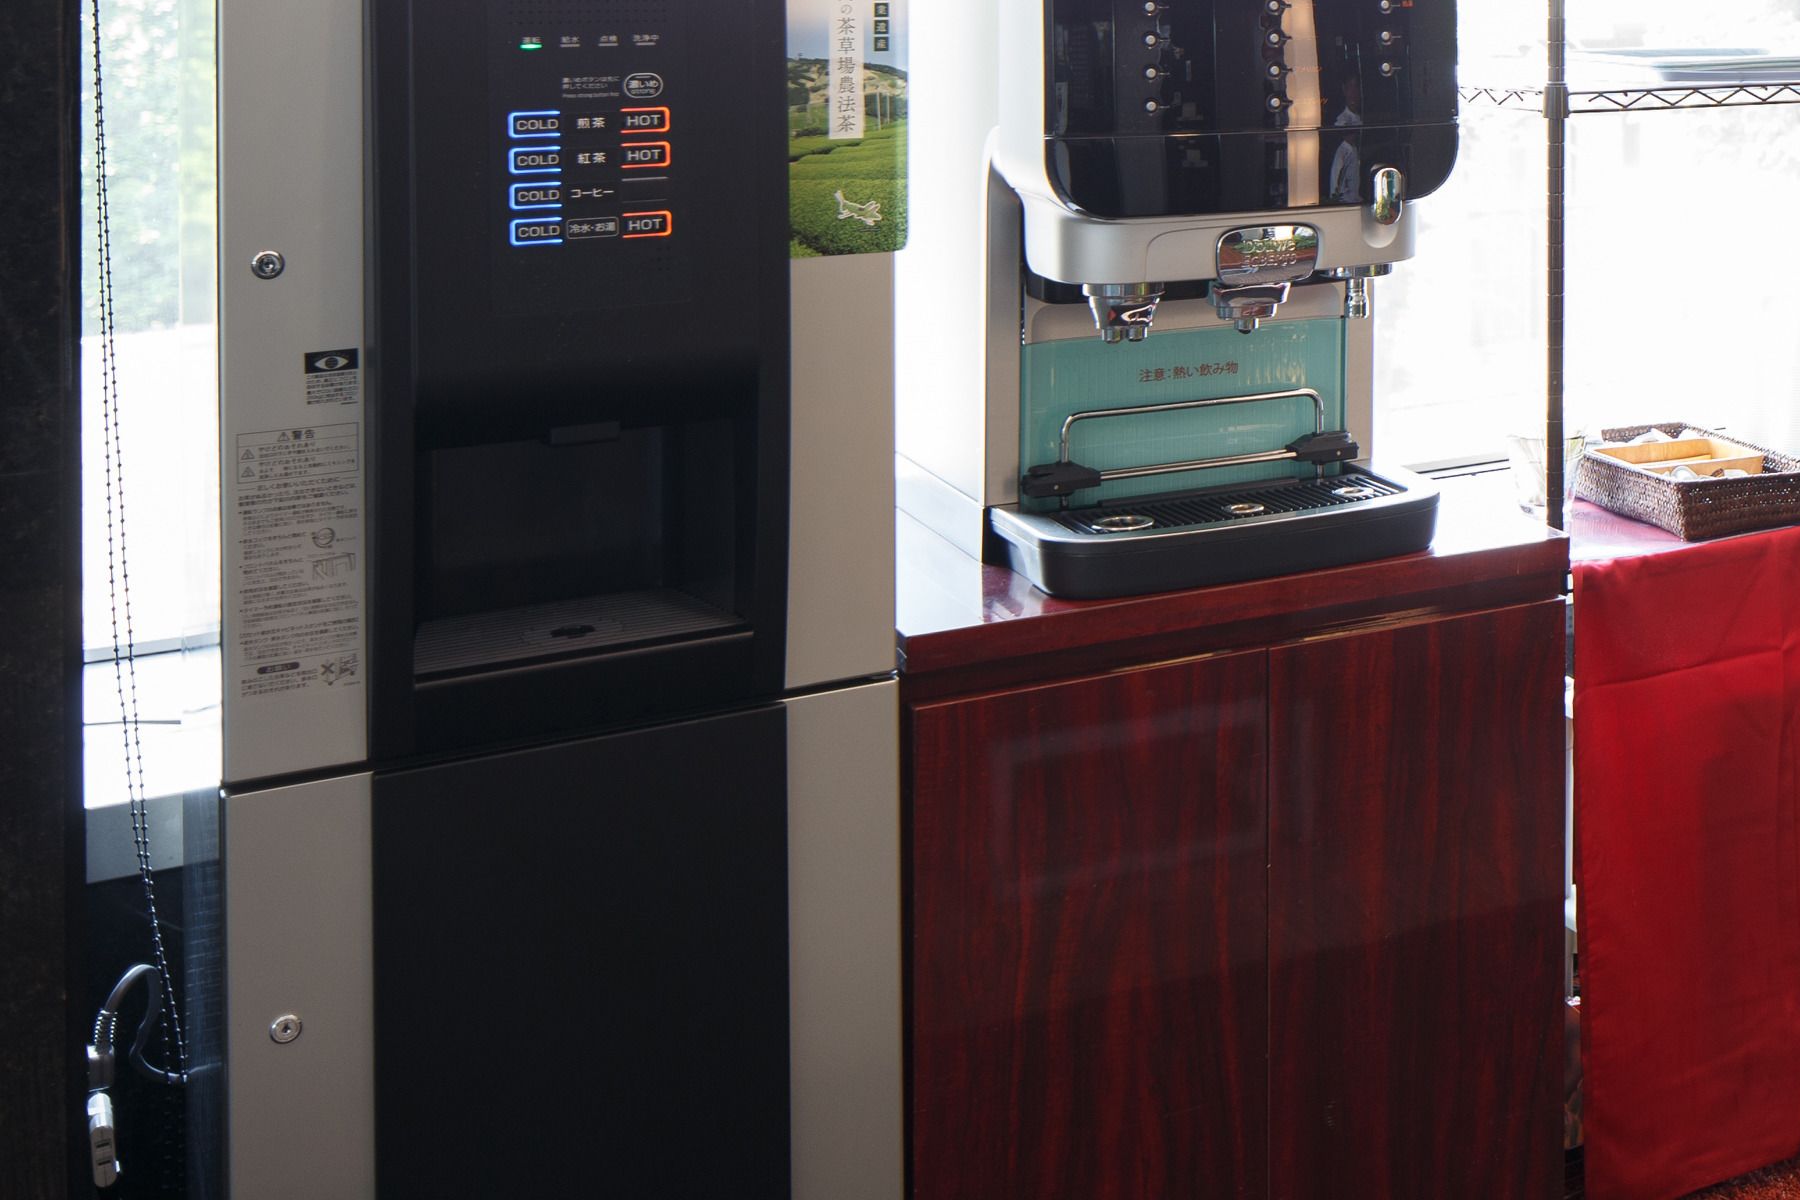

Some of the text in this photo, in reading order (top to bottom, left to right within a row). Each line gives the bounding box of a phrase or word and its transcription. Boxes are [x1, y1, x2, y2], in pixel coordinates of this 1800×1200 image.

[516, 118, 559, 130] COLD
[576, 117, 606, 129] 煎茶
[626, 114, 661, 126] HOT
[517, 154, 560, 166] COLD
[577, 152, 607, 164] 紅茶
[627, 149, 662, 161] HOT
[517, 189, 560, 202] COLD
[571, 188, 615, 198] コーヒー
[569, 221, 616, 234] 冷水・お湯
[628, 218, 663, 231] HOT
[518, 225, 560, 237] COLD
[1139, 361, 1239, 383] 注意:熱い飲み物
[292, 429, 315, 440] 警告
